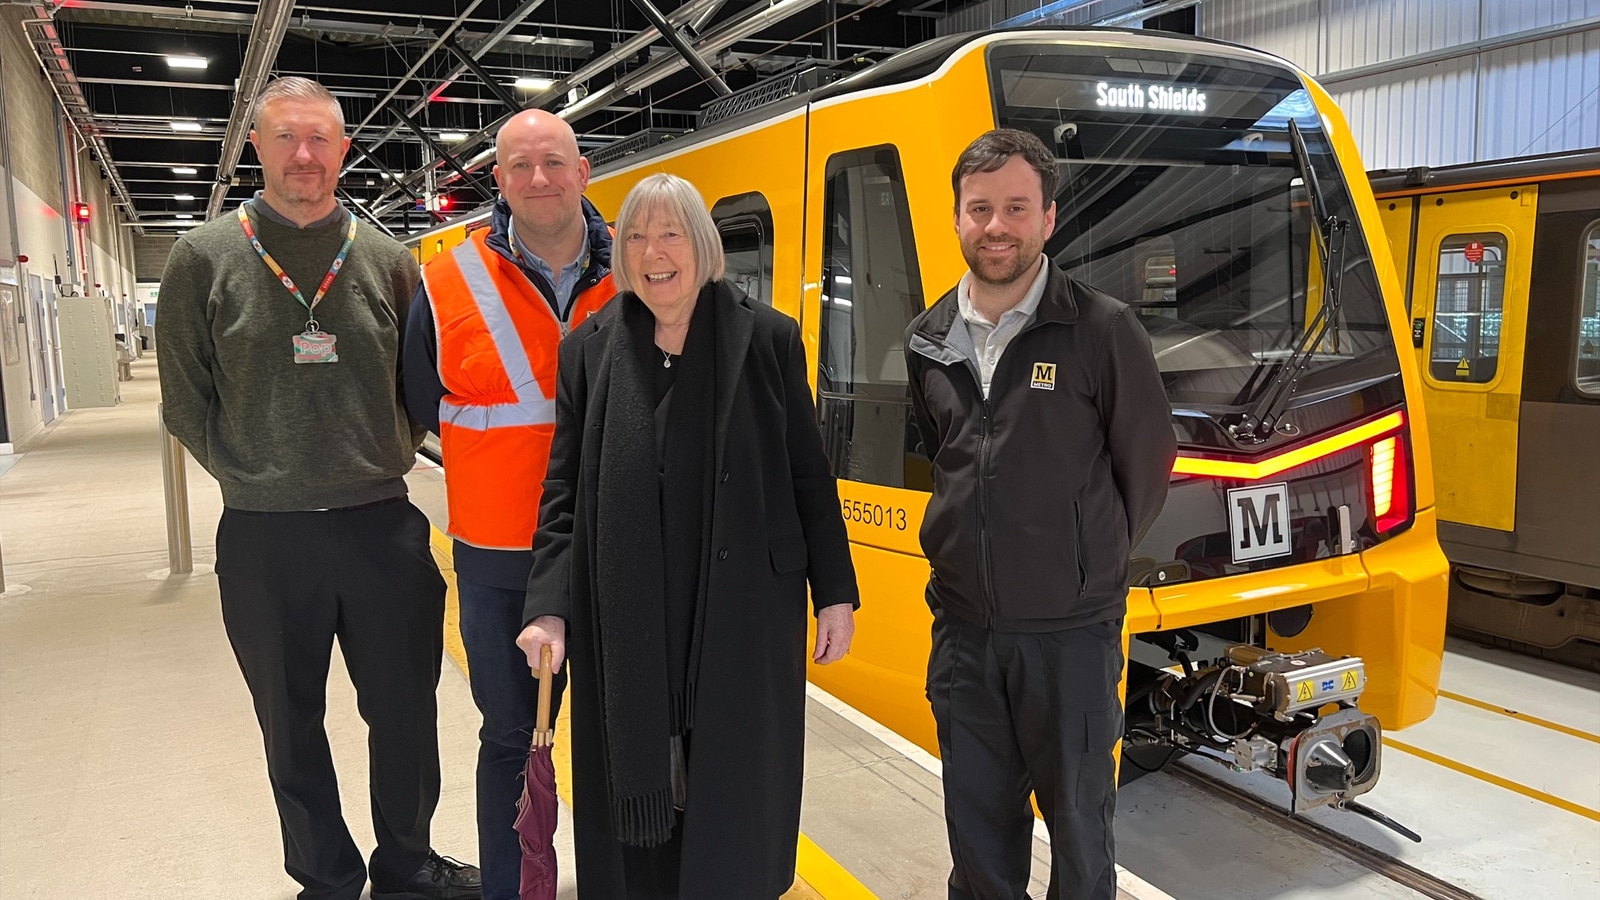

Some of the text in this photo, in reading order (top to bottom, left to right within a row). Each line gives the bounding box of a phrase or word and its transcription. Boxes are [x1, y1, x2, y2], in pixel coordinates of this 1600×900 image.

[1096, 82, 1206, 111] South Shields
[301, 341, 332, 357] Pop
[1035, 365, 1053, 381] M
[843, 499, 907, 531] 555013
[1237, 493, 1283, 549] M
